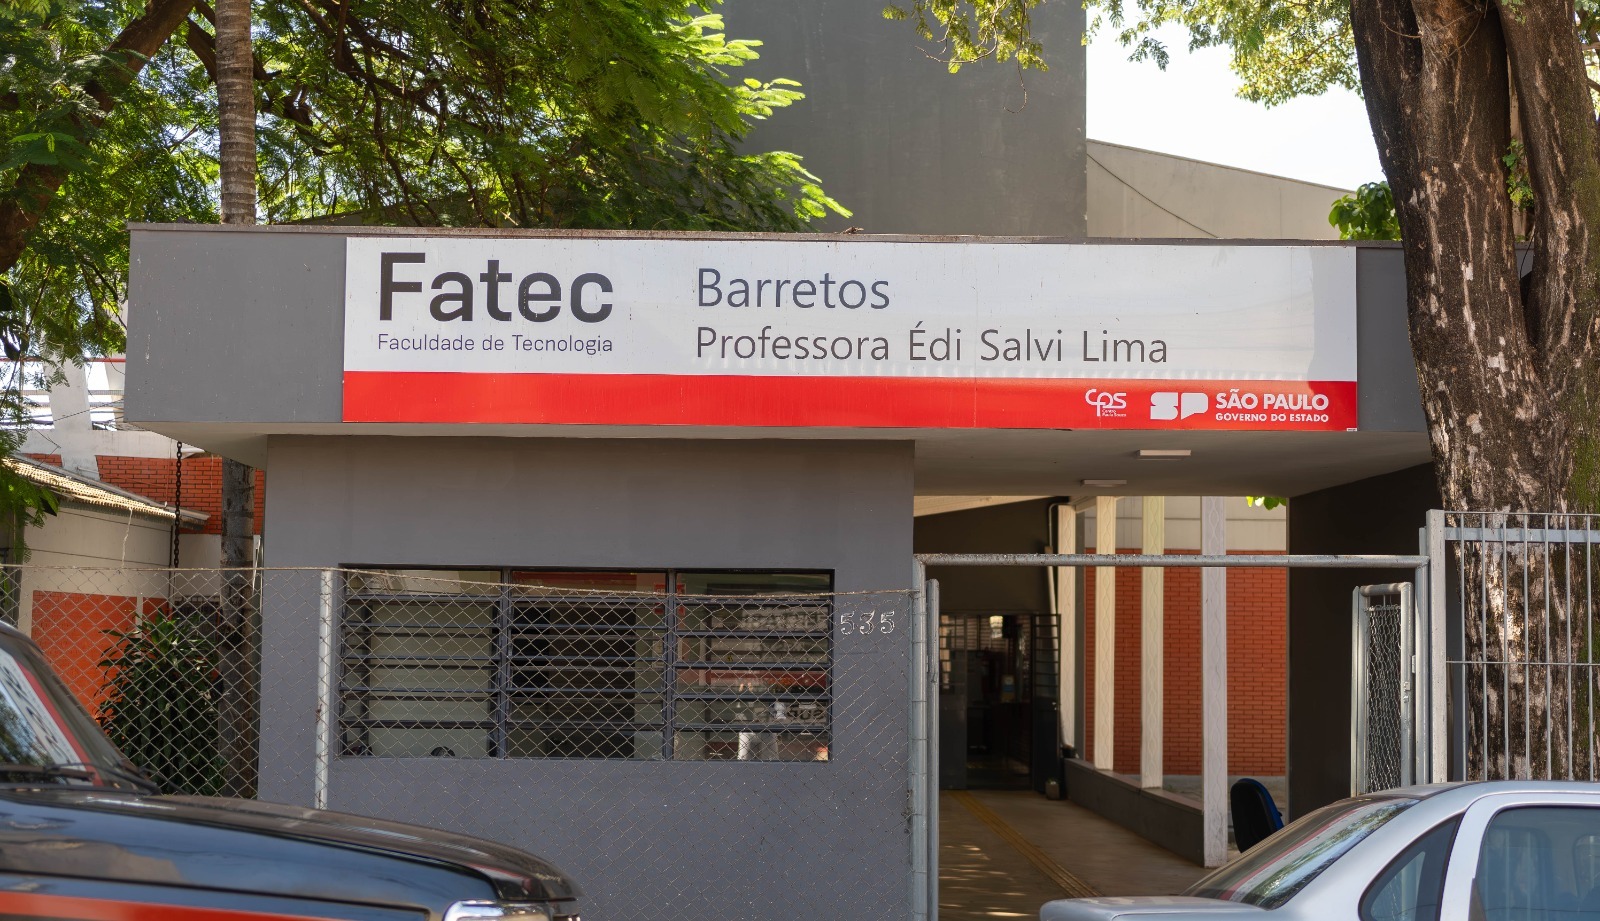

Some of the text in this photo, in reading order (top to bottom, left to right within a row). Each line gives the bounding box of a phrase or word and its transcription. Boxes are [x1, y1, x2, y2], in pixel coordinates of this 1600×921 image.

[379, 251, 613, 323] Fatec
[697, 267, 890, 310] Barretos
[378, 333, 613, 356] Faculdade de Tecnologia
[697, 320, 1167, 363] Professora Édi Salvi Lima
[1215, 388, 1329, 411] SÃO PAULO
[1215, 412, 1329, 423] GOVERNO DO ESTADO
[840, 609, 895, 635] 535
